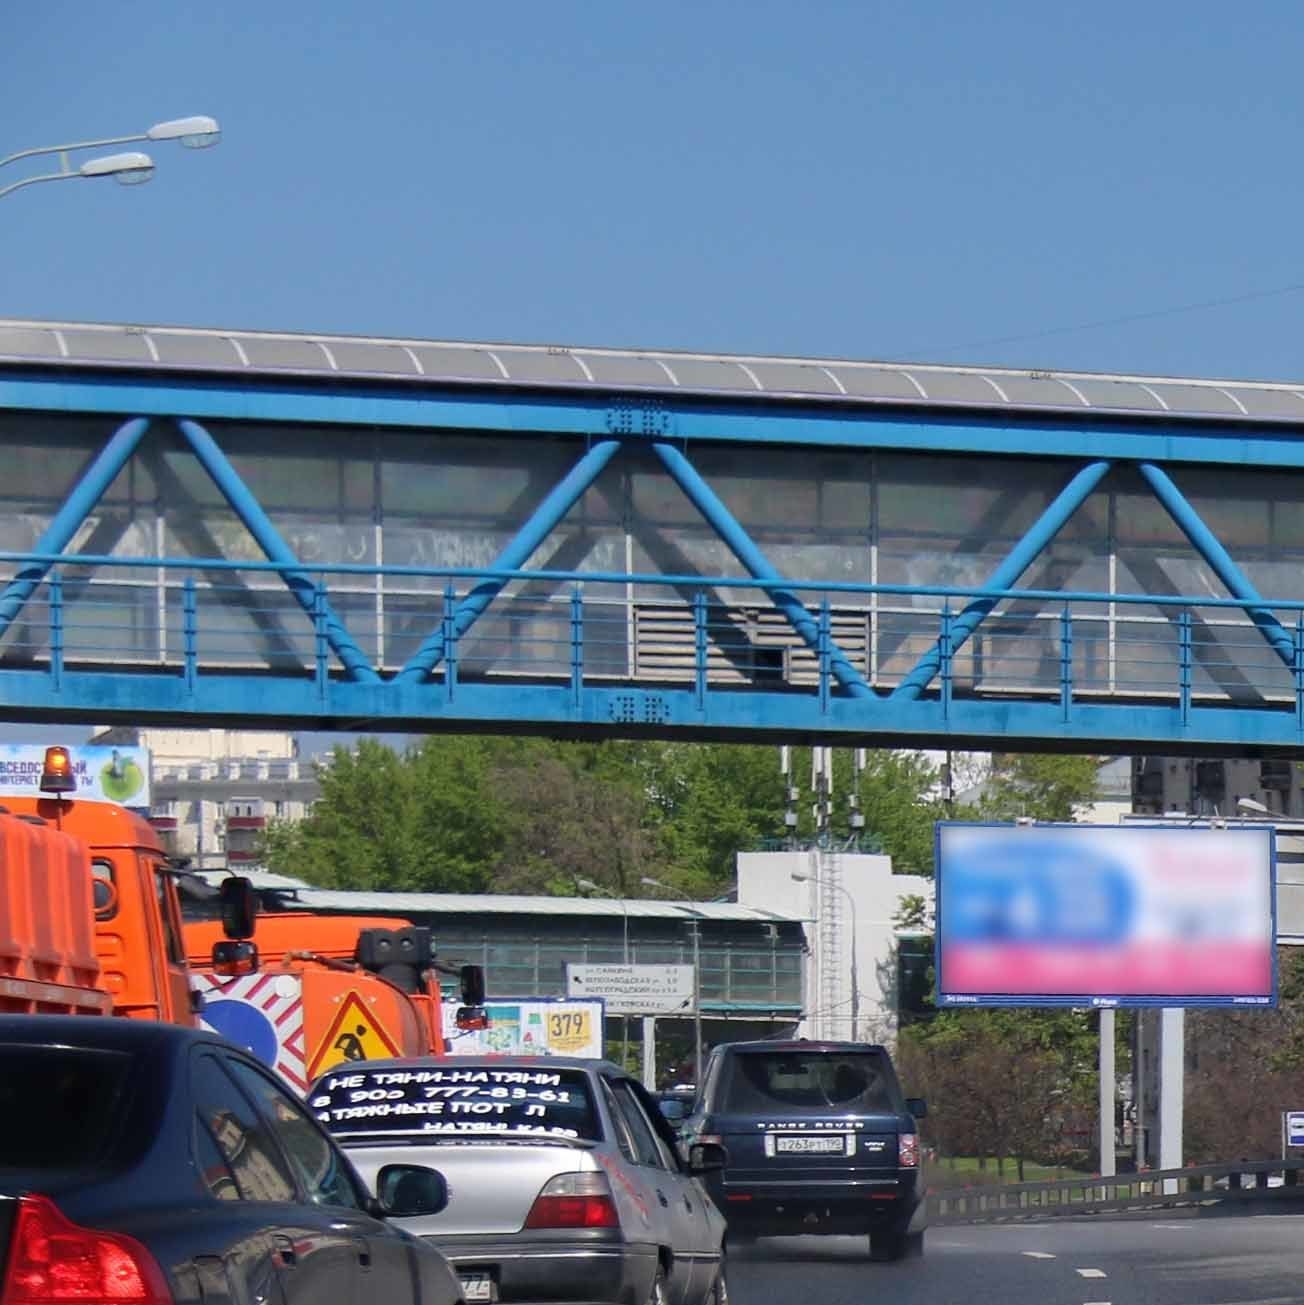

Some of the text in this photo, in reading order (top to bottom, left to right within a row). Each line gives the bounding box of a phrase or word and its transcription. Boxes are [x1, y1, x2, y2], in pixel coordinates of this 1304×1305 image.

[551, 1013, 583, 1037] 379
[329, 1075, 365, 1090] НЕ
[313, 1096, 331, 1108] 8
